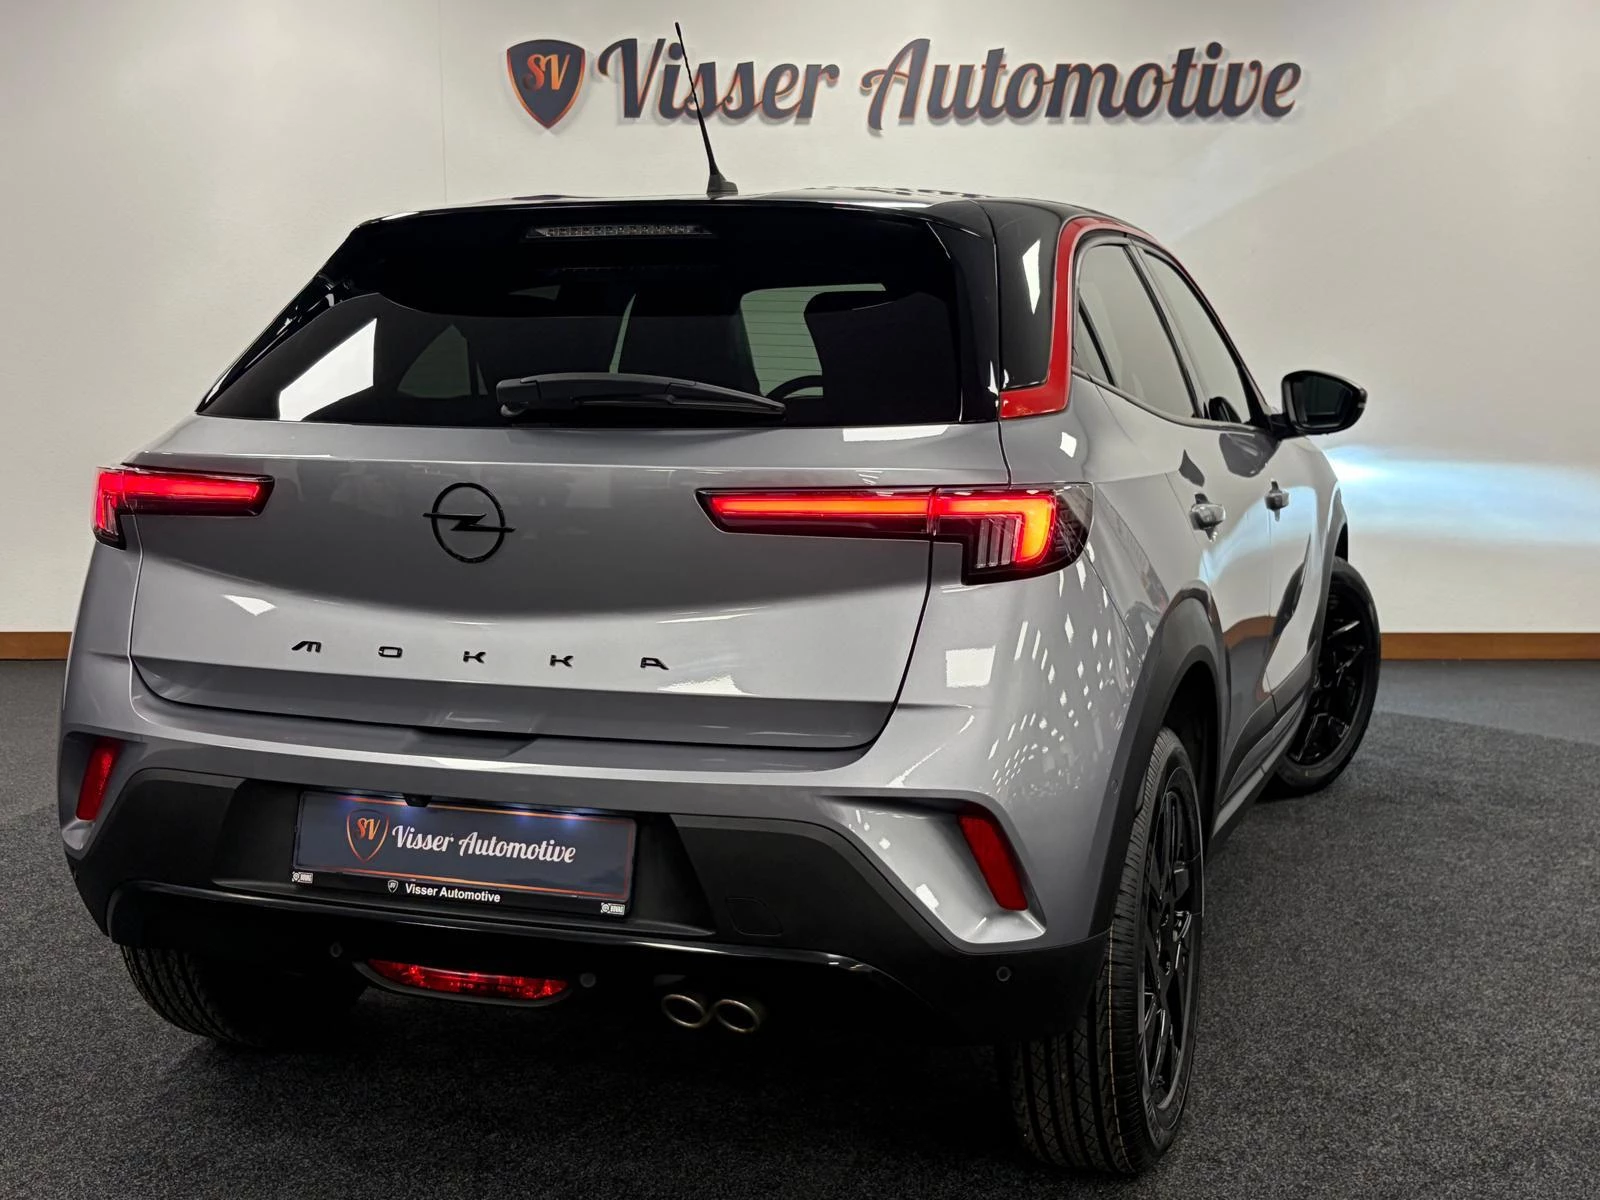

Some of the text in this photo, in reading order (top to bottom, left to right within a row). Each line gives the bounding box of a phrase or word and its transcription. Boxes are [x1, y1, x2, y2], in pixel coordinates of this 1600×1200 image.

[522, 53, 571, 91] SV
[598, 38, 1302, 131] Visser Automotive
[291, 640, 669, 671] MOKKA
[391, 825, 577, 863] Visser Automotive
[405, 883, 501, 902] Visser Automotive
